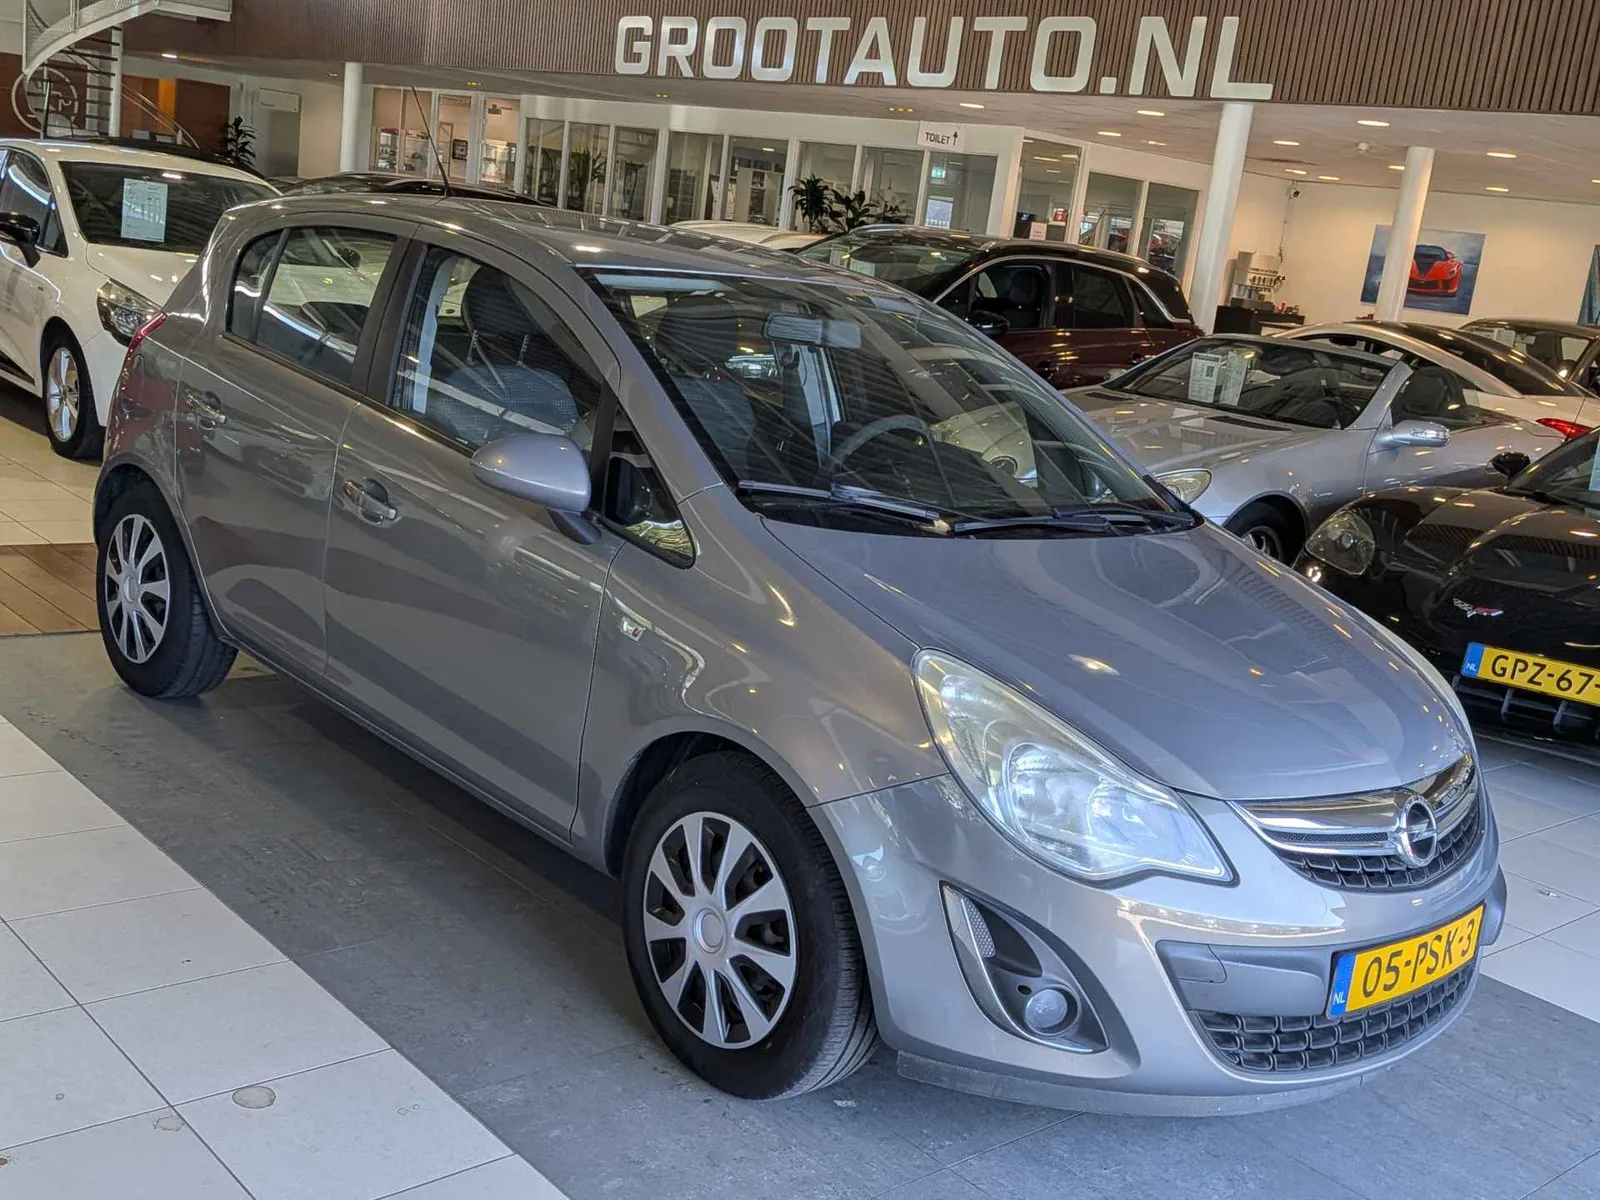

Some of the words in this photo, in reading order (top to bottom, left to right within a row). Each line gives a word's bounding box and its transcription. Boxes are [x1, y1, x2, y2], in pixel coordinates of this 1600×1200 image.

[615, 16, 1274, 99] GROOTAUTO.NL
[925, 132, 950, 145] TOILET
[1466, 662, 1477, 671] NL
[1362, 918, 1475, 999] 05-PSK-3
[1333, 991, 1346, 1004] NL
